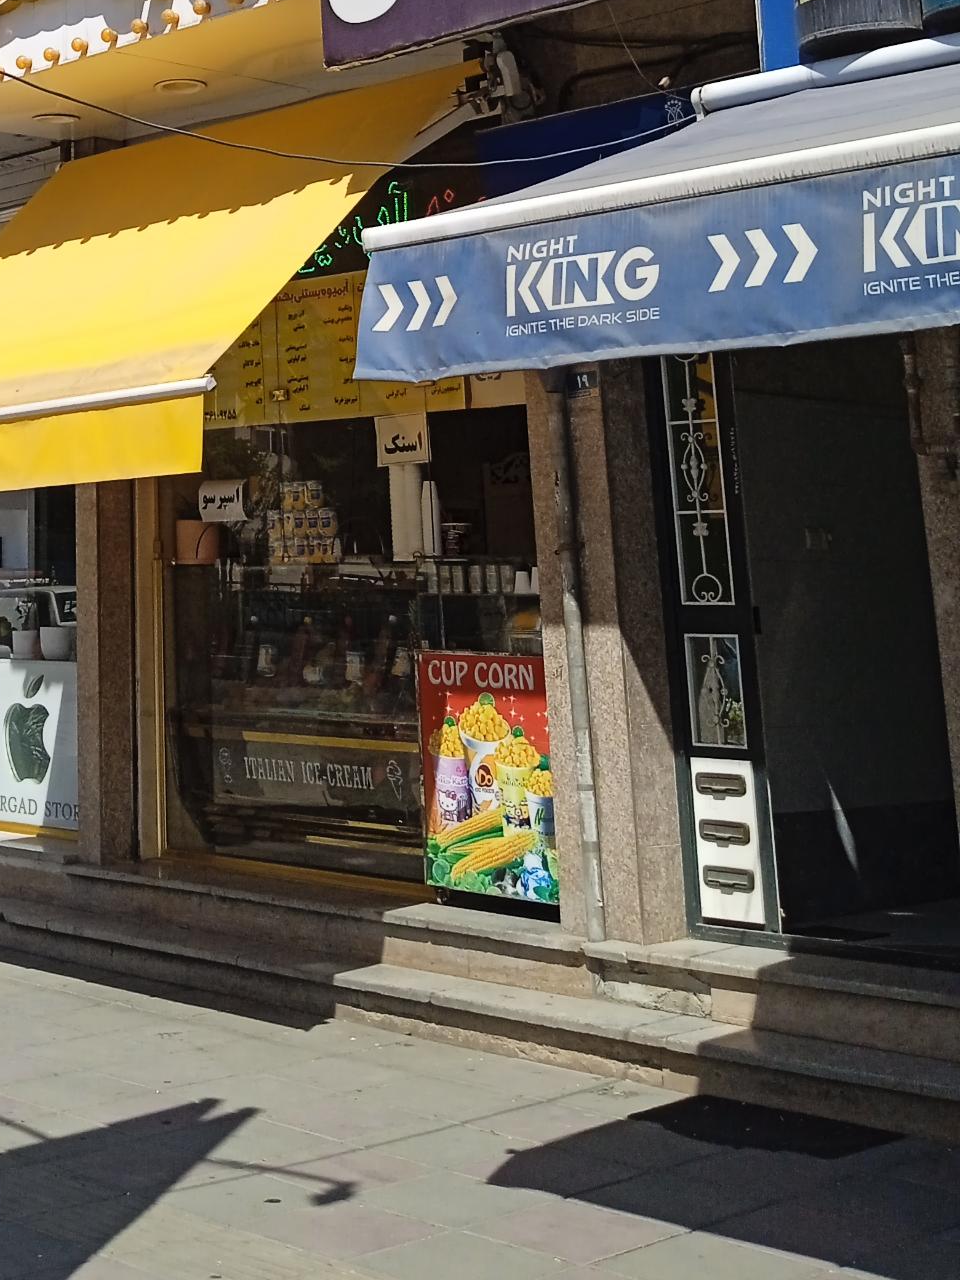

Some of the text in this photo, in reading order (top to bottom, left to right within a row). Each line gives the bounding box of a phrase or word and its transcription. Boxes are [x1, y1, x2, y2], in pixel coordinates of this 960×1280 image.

[862, 175, 955, 211] NIGHT
[506, 234, 578, 263] NIGHT
[505, 246, 660, 318] KING
[863, 276, 922, 296] IGNITE
[505, 308, 661, 337] IGNITE THE DARK SIDE
[384, 430, 423, 456] اسنک
[427, 659, 535, 691] CUP CORN
[243, 756, 375, 790] ITALIAN ICE-CREAM
